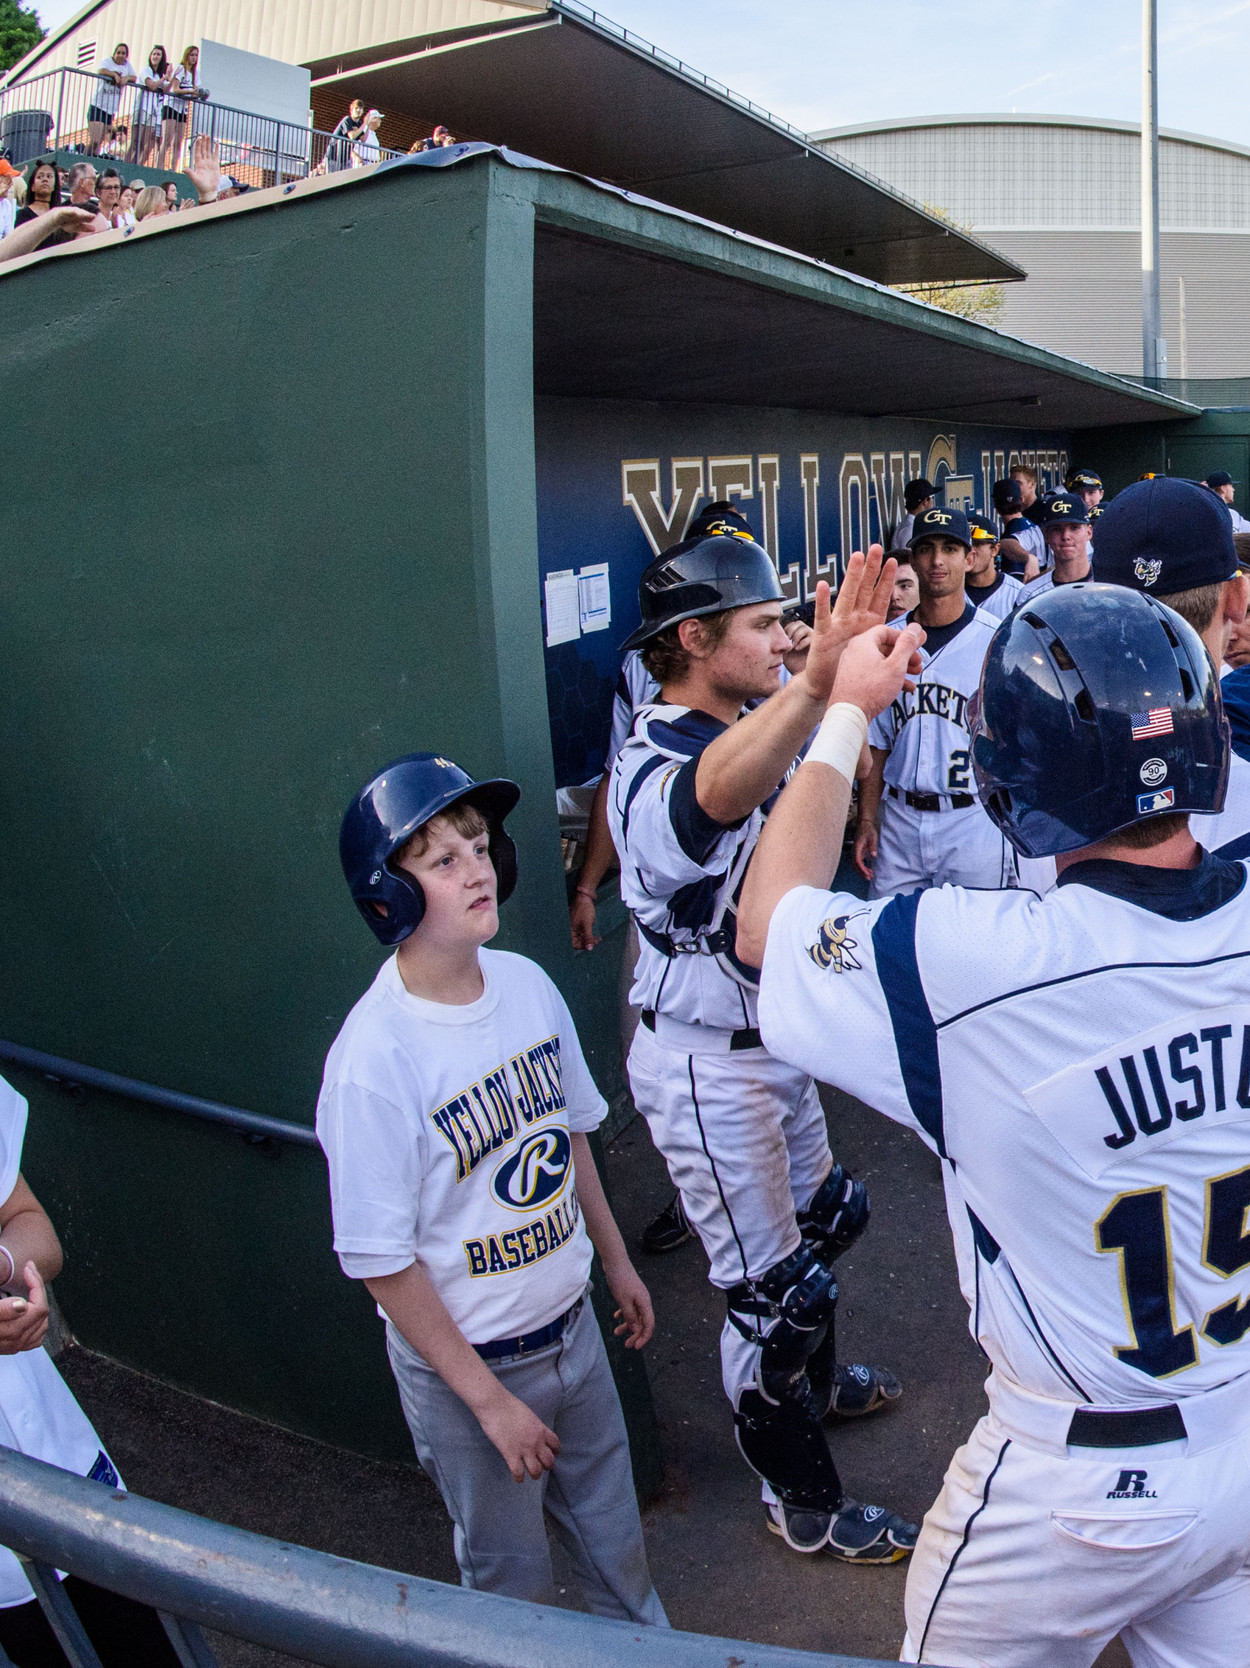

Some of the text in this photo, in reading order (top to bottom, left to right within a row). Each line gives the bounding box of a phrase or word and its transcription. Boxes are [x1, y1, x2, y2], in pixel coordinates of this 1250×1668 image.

[1051, 501, 1072, 514] GT
[923, 509, 952, 525] GT
[888, 683, 971, 742] ACKET
[1149, 766, 1158, 775] 90
[429, 1064, 522, 1184] YELLOW
[1106, 1489, 1158, 1499] RUSSELL
